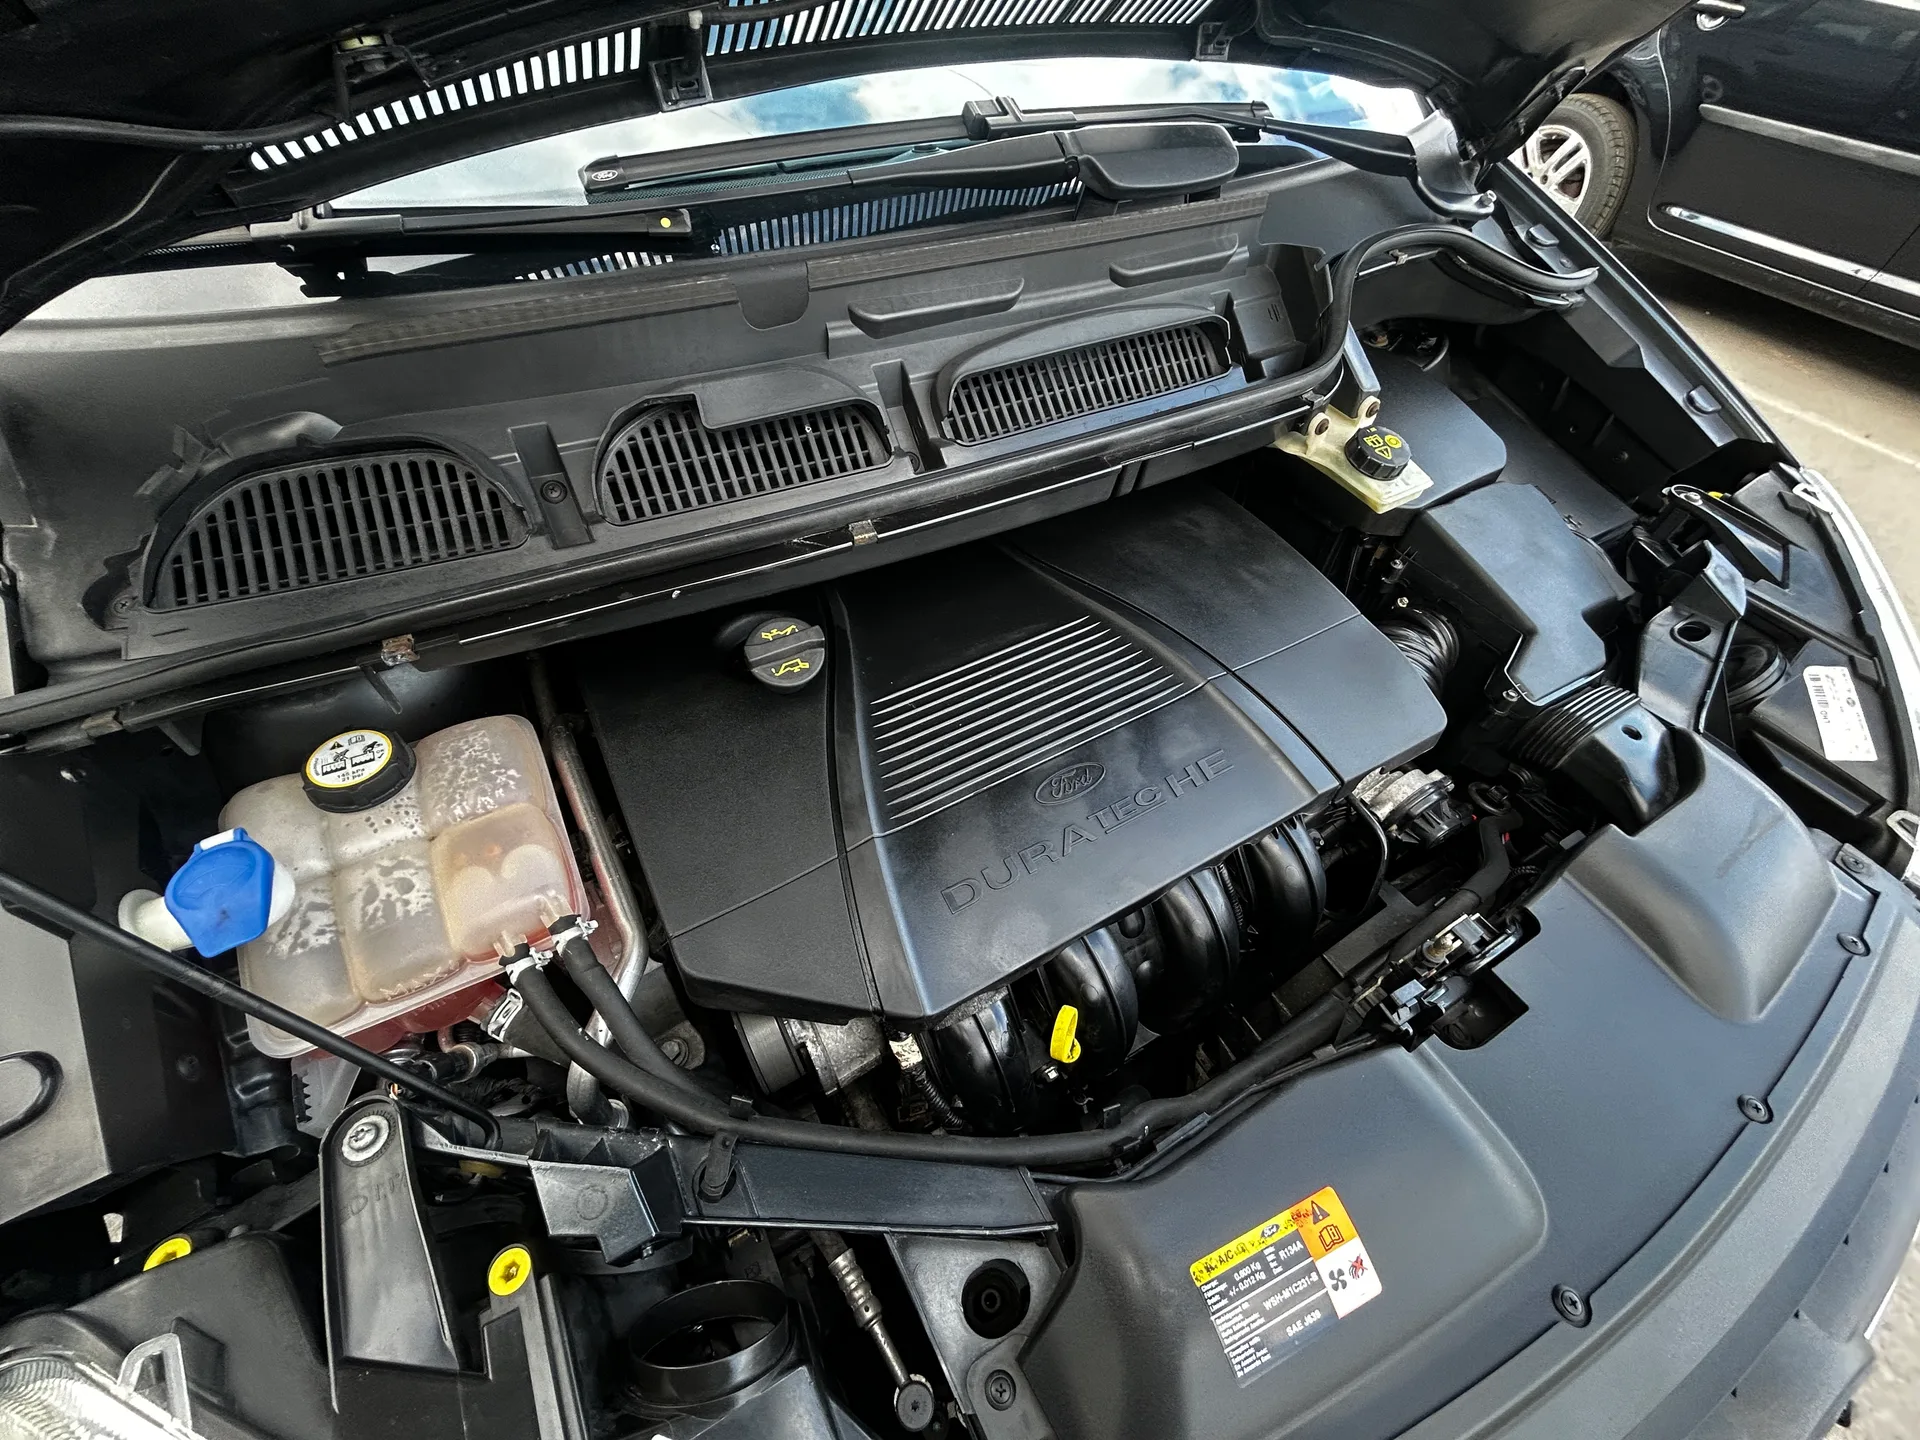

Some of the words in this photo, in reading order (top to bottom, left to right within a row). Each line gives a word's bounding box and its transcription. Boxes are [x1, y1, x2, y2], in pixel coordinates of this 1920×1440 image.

[1218, 1249, 1234, 1265] A/C
[1279, 1240, 1304, 1261] R134A
[1250, 1261, 1262, 1273] Kg
[1239, 1277, 1258, 1292] 0.012
[1254, 1271, 1266, 1284] Kg
[1286, 1321, 1304, 1337] SAE
